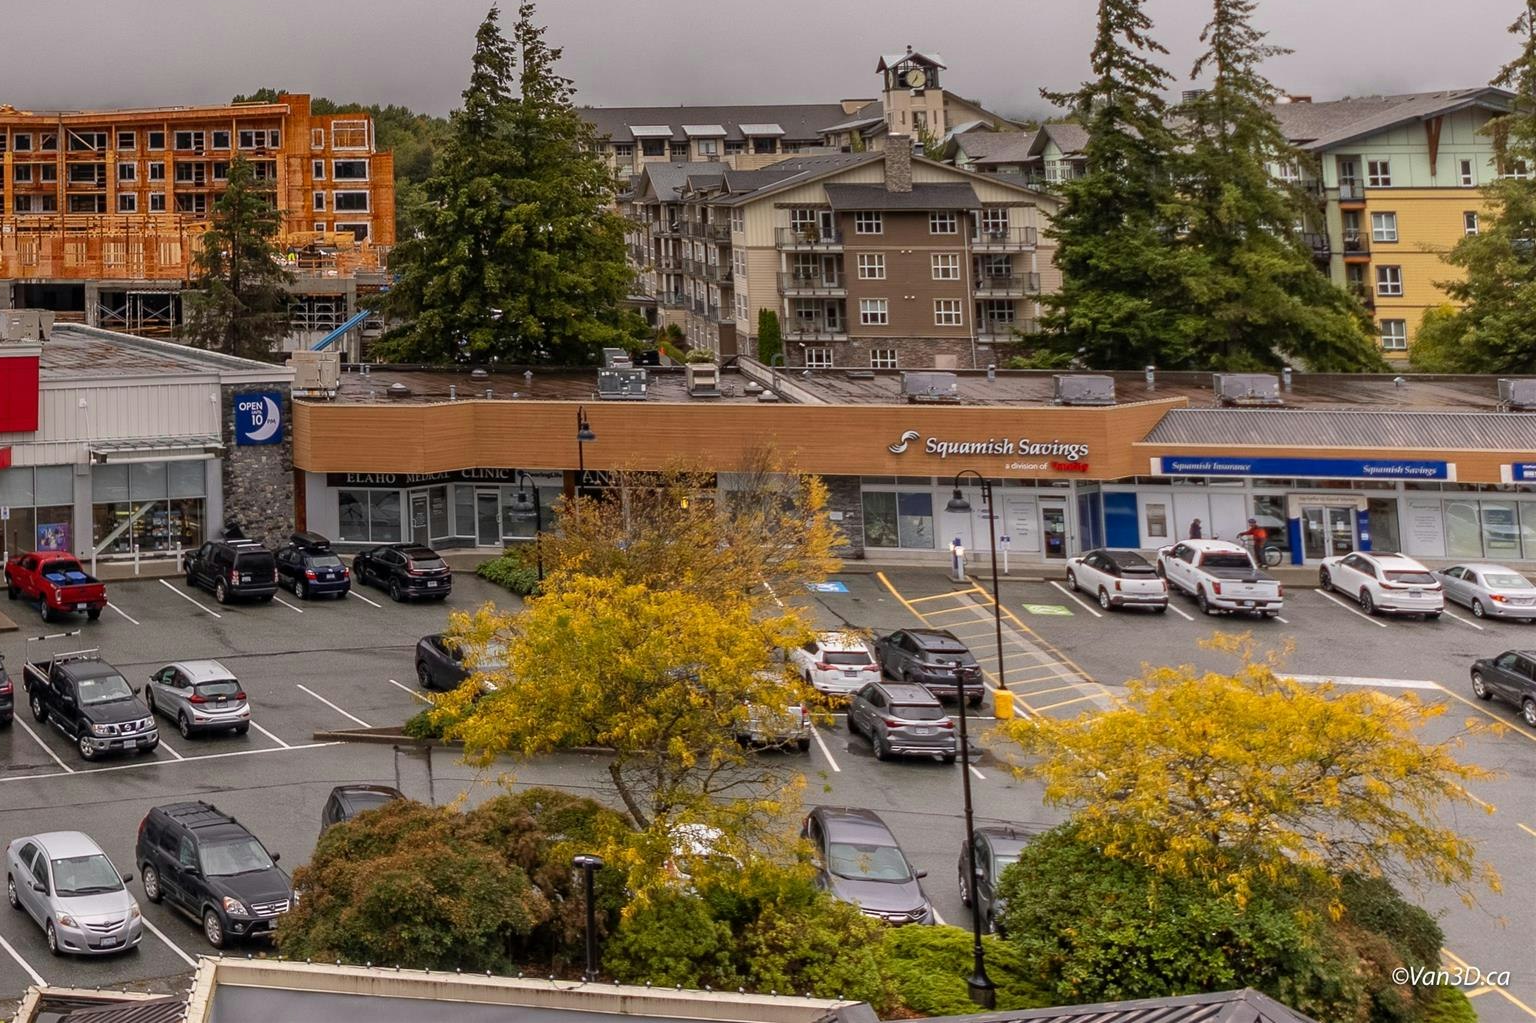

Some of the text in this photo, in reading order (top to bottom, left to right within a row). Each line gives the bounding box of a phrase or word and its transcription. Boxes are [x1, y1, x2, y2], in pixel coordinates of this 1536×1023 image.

[239, 402, 263, 411] OPEN
[251, 414, 263, 426] 10
[925, 437, 1089, 461] Squamish Savings
[1011, 462, 1038, 470] division
[1039, 462, 1048, 470] of
[1171, 461, 1251, 472] Squamish Insurance
[1363, 464, 1437, 476] Squamish Savings
[346, 472, 396, 484] ELAHO
[461, 468, 510, 479] CLINIC
